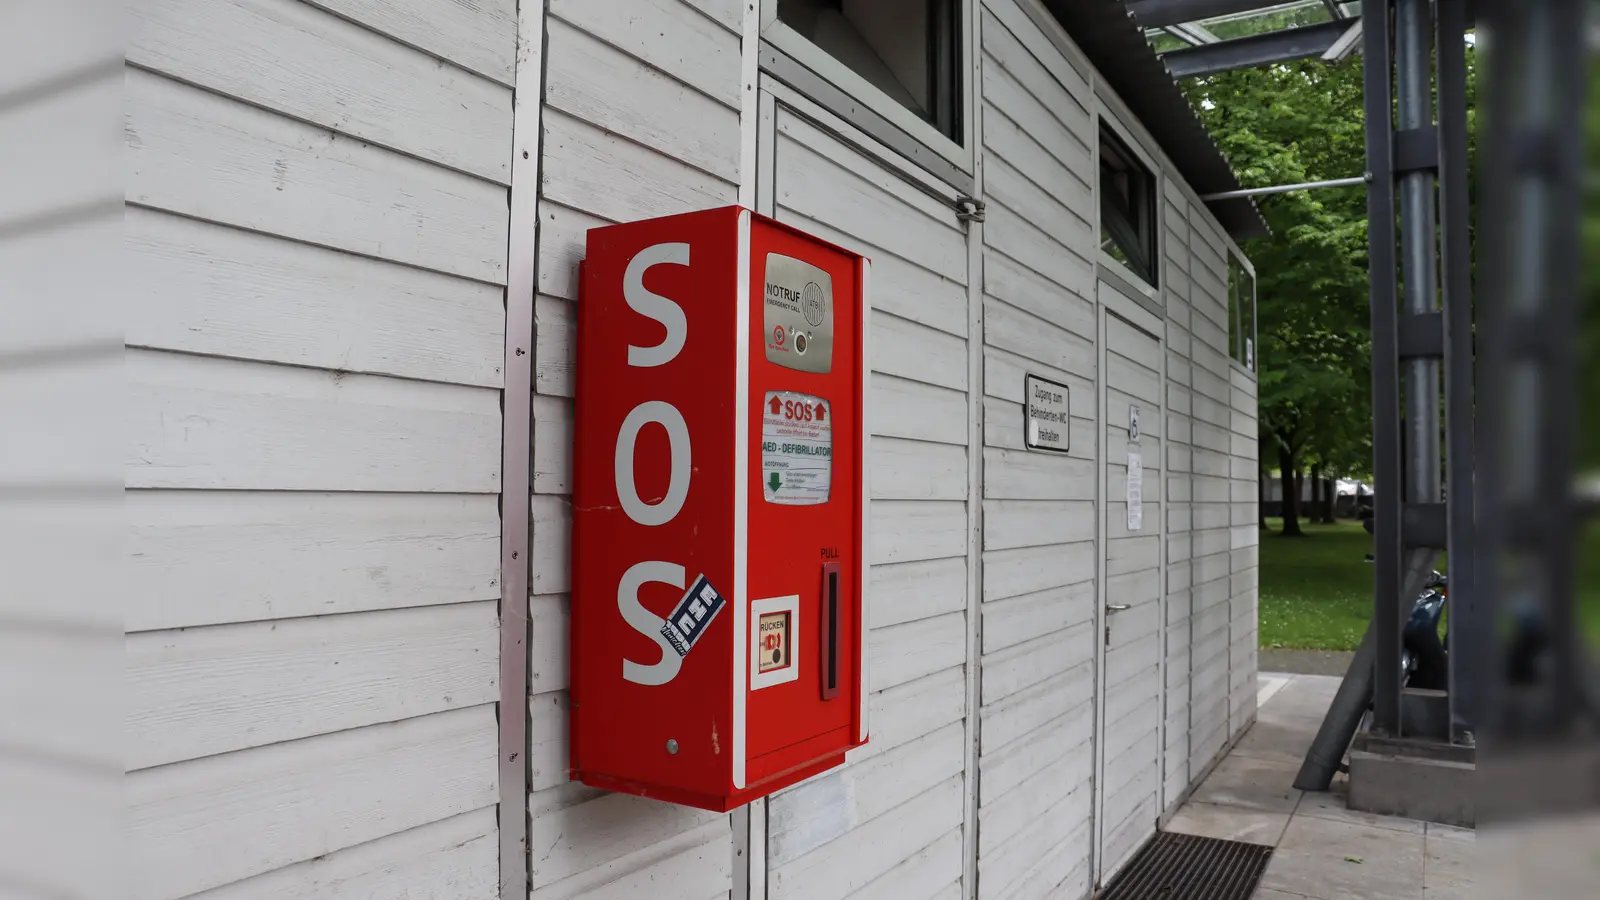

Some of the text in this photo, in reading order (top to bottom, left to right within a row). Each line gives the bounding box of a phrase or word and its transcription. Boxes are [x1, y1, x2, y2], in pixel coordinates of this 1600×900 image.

[766, 282, 801, 303] NOTRUF
[766, 298, 801, 314] EMERGENCY CALL
[1035, 384, 1063, 404] Zugang zum
[785, 399, 813, 422] SOS
[1030, 404, 1067, 424] Behinderten-WC
[1038, 427, 1060, 442] freihalten
[762, 441, 777, 452] AED
[782, 443, 832, 457] DEFIBRILLATOR
[614, 242, 692, 686] SOS
[820, 547, 839, 559] PULL
